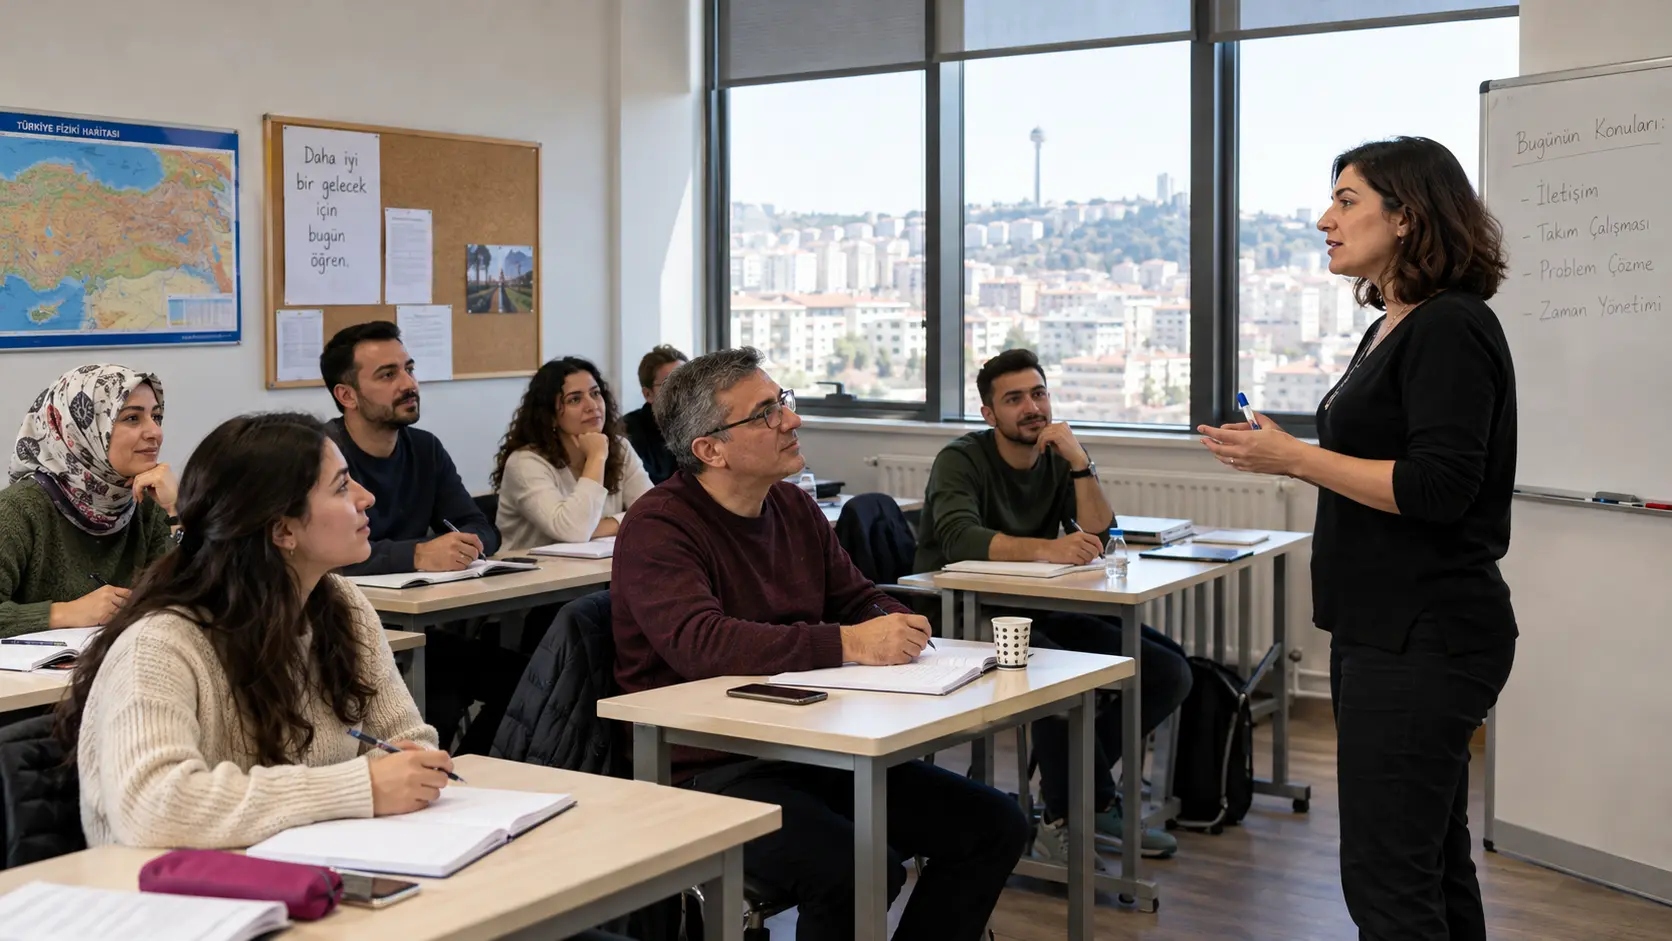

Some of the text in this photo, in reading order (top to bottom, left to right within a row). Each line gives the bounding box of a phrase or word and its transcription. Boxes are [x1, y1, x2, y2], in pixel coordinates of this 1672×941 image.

[16, 120, 120, 138] TÜRKİYE FİZİKİ HARİTASI
[1516, 114, 1666, 160] Bugünün Konuları:
[304, 145, 358, 173] Daha iyi
[296, 172, 367, 200] bir gelecek
[1536, 179, 1599, 206] İletişim
[316, 203, 338, 221] için
[308, 225, 346, 250] bugün
[1537, 221, 1579, 242] Takım
[1589, 214, 1651, 239] Çalışması
[310, 252, 350, 275] öğren.
[1540, 258, 1597, 281] Problem
[1608, 253, 1654, 276] Çözme
[1539, 299, 1587, 321] Zaman
[1597, 295, 1662, 317] Yönetimi
